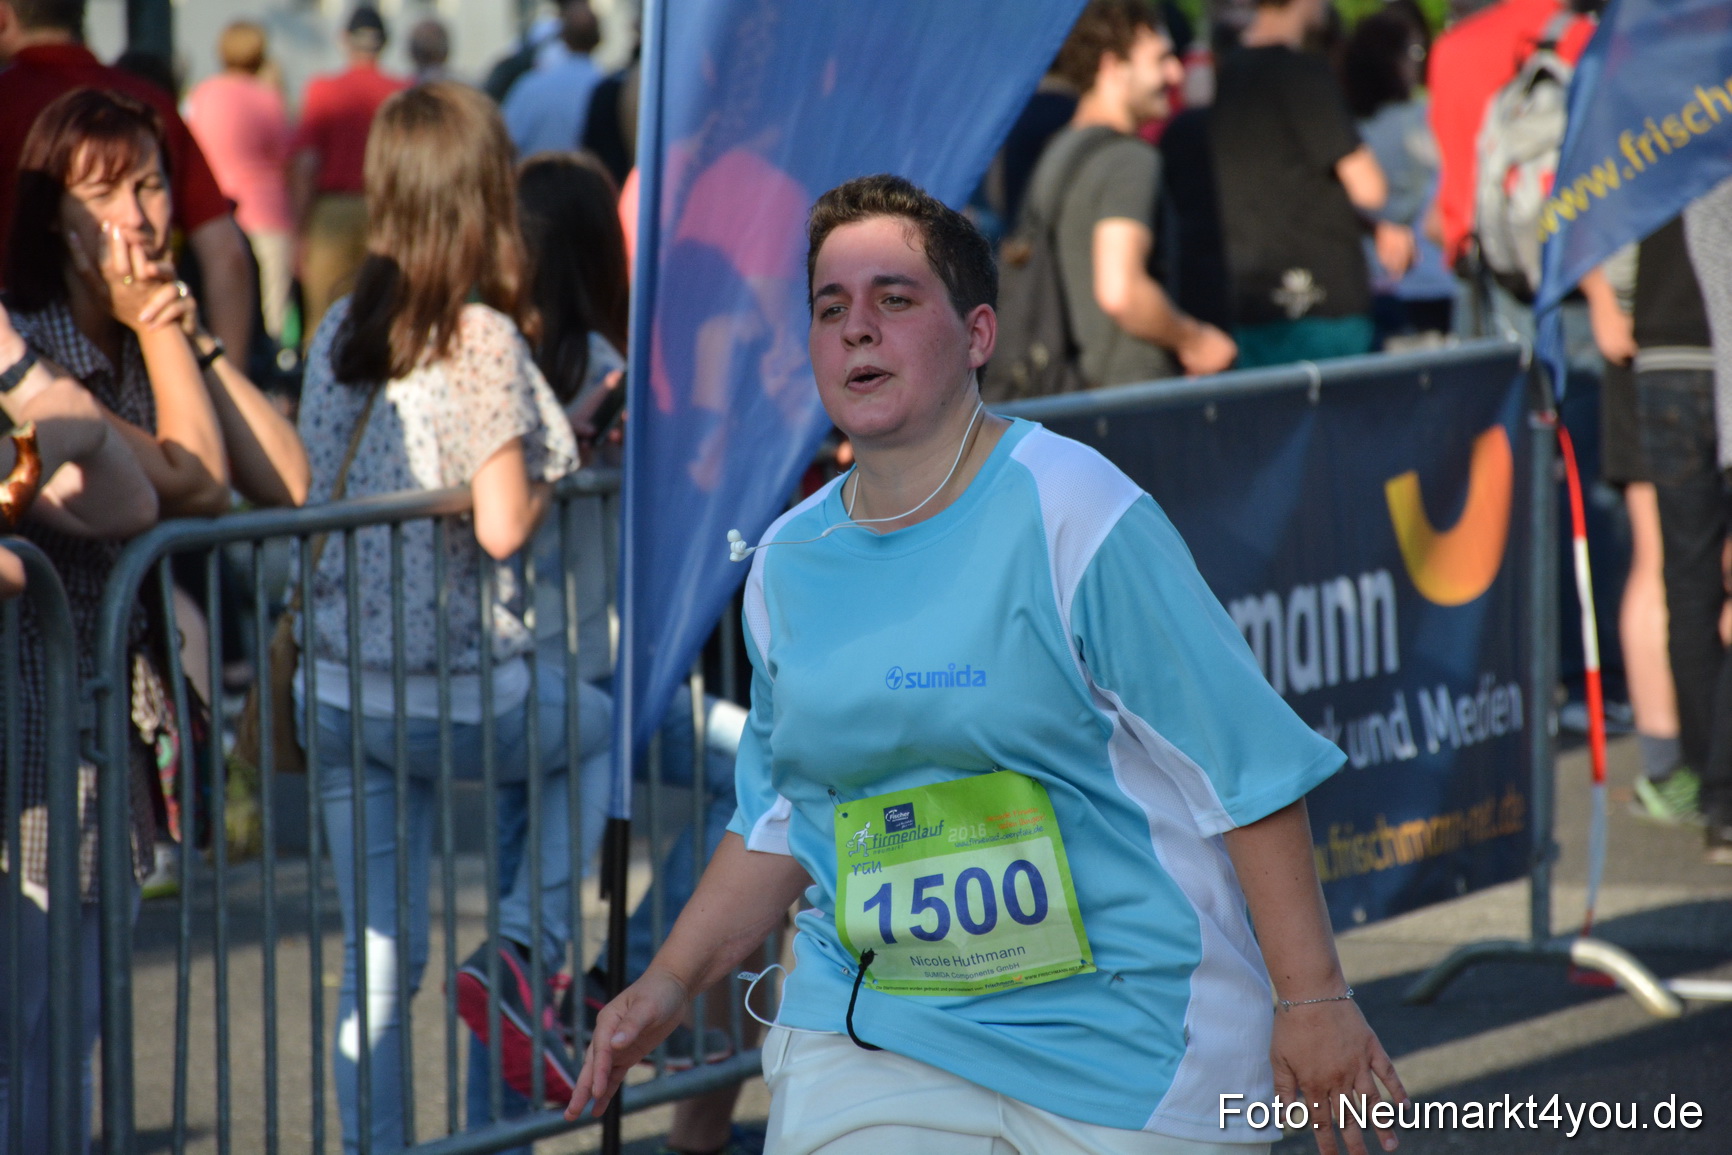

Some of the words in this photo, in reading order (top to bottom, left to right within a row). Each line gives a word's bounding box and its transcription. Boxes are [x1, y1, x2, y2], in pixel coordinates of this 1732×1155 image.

[1537, 77, 1732, 243] www.frisch
[905, 662, 987, 689] sumida
[1348, 689, 1418, 770] und
[1419, 674, 1525, 755] Medien
[872, 819, 945, 849] firmenlauf
[948, 823, 987, 842] 2016
[863, 859, 1048, 945] 1500
[910, 955, 951, 967] Nicole
[952, 945, 1026, 968] Huthmann
[951, 968, 995, 980] Components
[996, 962, 1020, 973] GmbH
